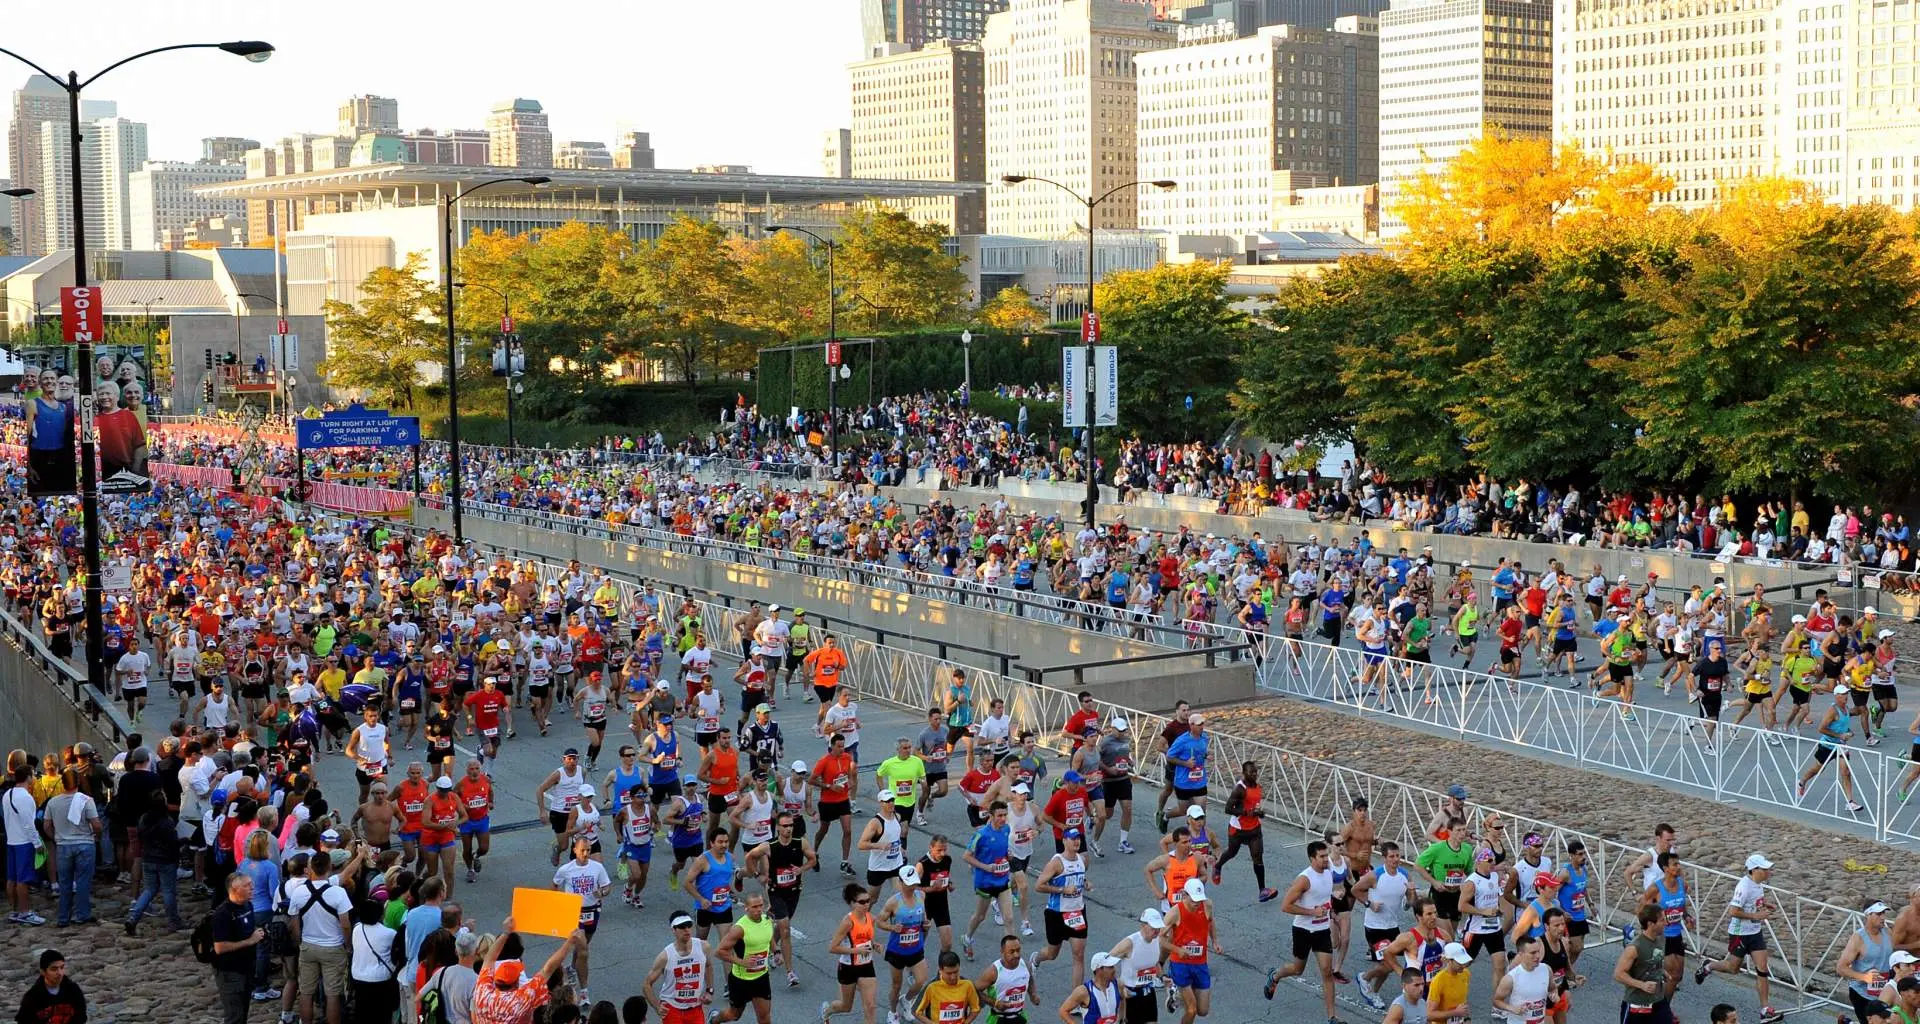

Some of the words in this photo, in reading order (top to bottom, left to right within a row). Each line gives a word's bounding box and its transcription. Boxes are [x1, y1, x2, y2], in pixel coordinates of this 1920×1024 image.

[82, 397, 93, 441] C11N
[341, 420, 364, 428] RIGHT
[295, 486, 313, 494] SOP
